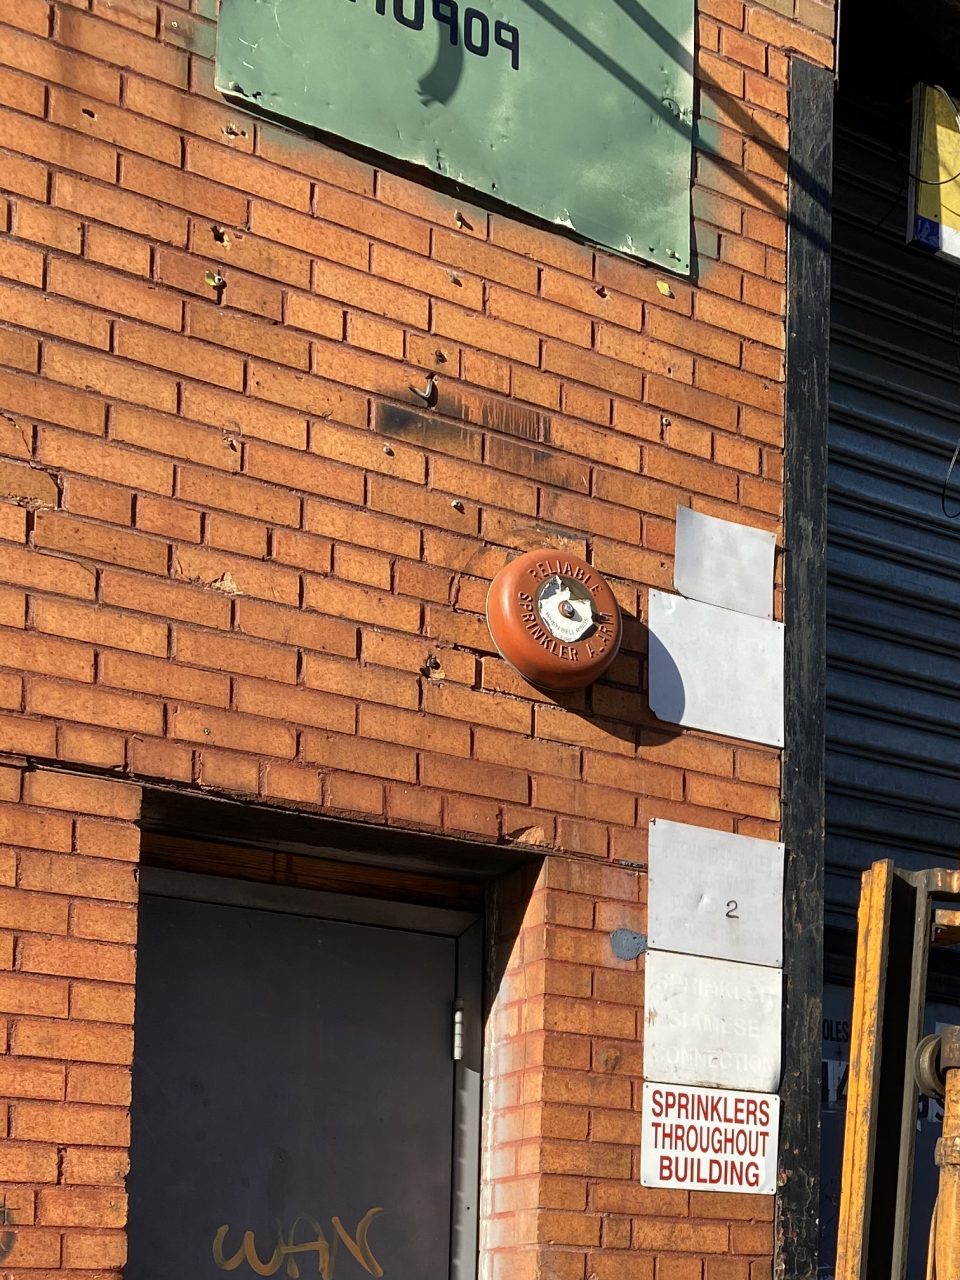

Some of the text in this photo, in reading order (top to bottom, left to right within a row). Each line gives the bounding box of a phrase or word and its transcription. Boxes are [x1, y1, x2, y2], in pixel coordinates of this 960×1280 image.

[348, 0, 519, 71] 0909
[528, 560, 604, 597] RELIABLE
[518, 591, 579, 661] SPRINKLER
[725, 899, 740, 919] 2
[651, 1089, 770, 1127] SPRINKLERS
[651, 1122, 769, 1158] THROUGHOUT
[659, 1155, 760, 1187] BUILDING
